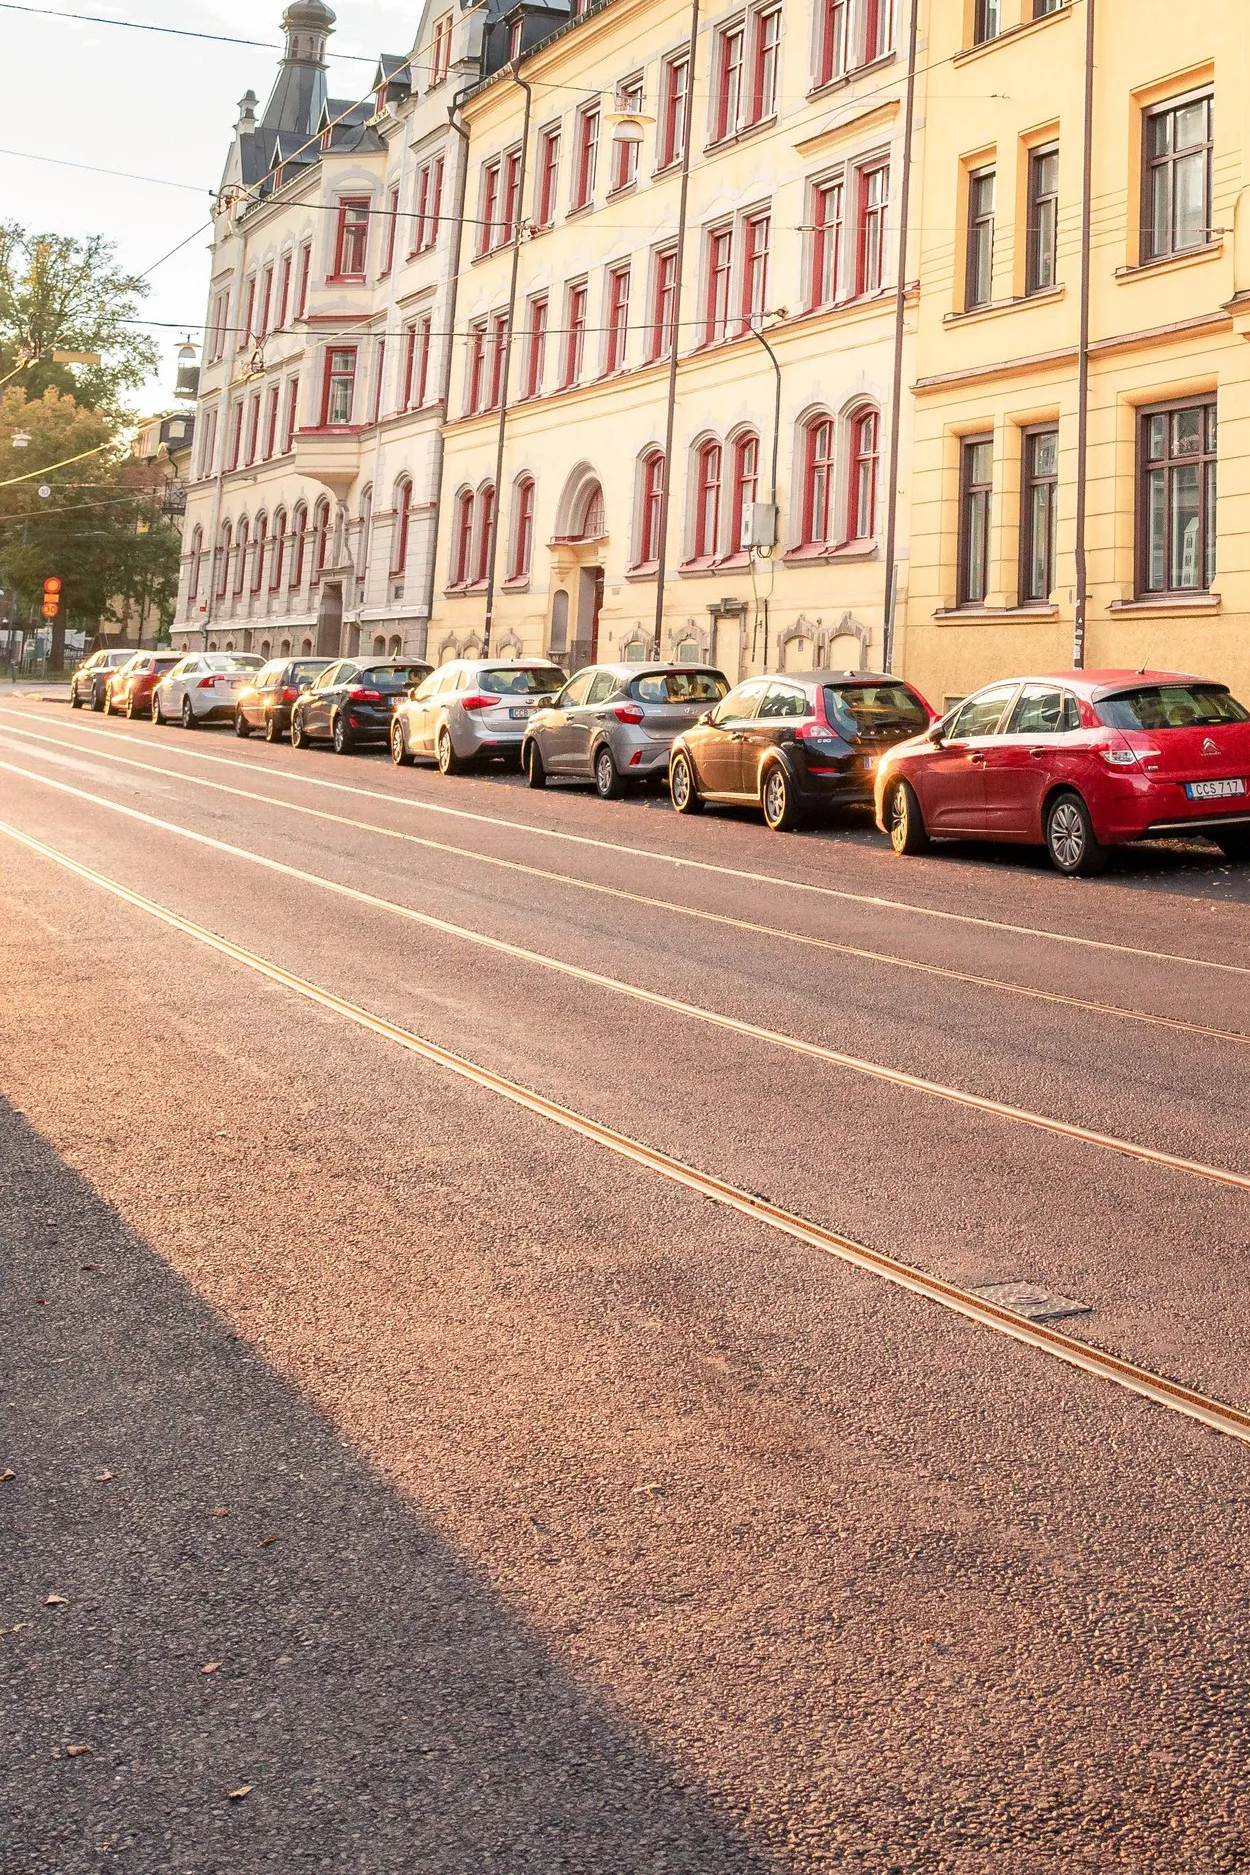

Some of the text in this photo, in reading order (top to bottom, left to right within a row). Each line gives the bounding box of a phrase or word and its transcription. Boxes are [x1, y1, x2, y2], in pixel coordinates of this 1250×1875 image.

[46, 605, 54, 613] 30
[514, 709, 529, 717] CCB
[1196, 781, 1239, 795] CCS 717
